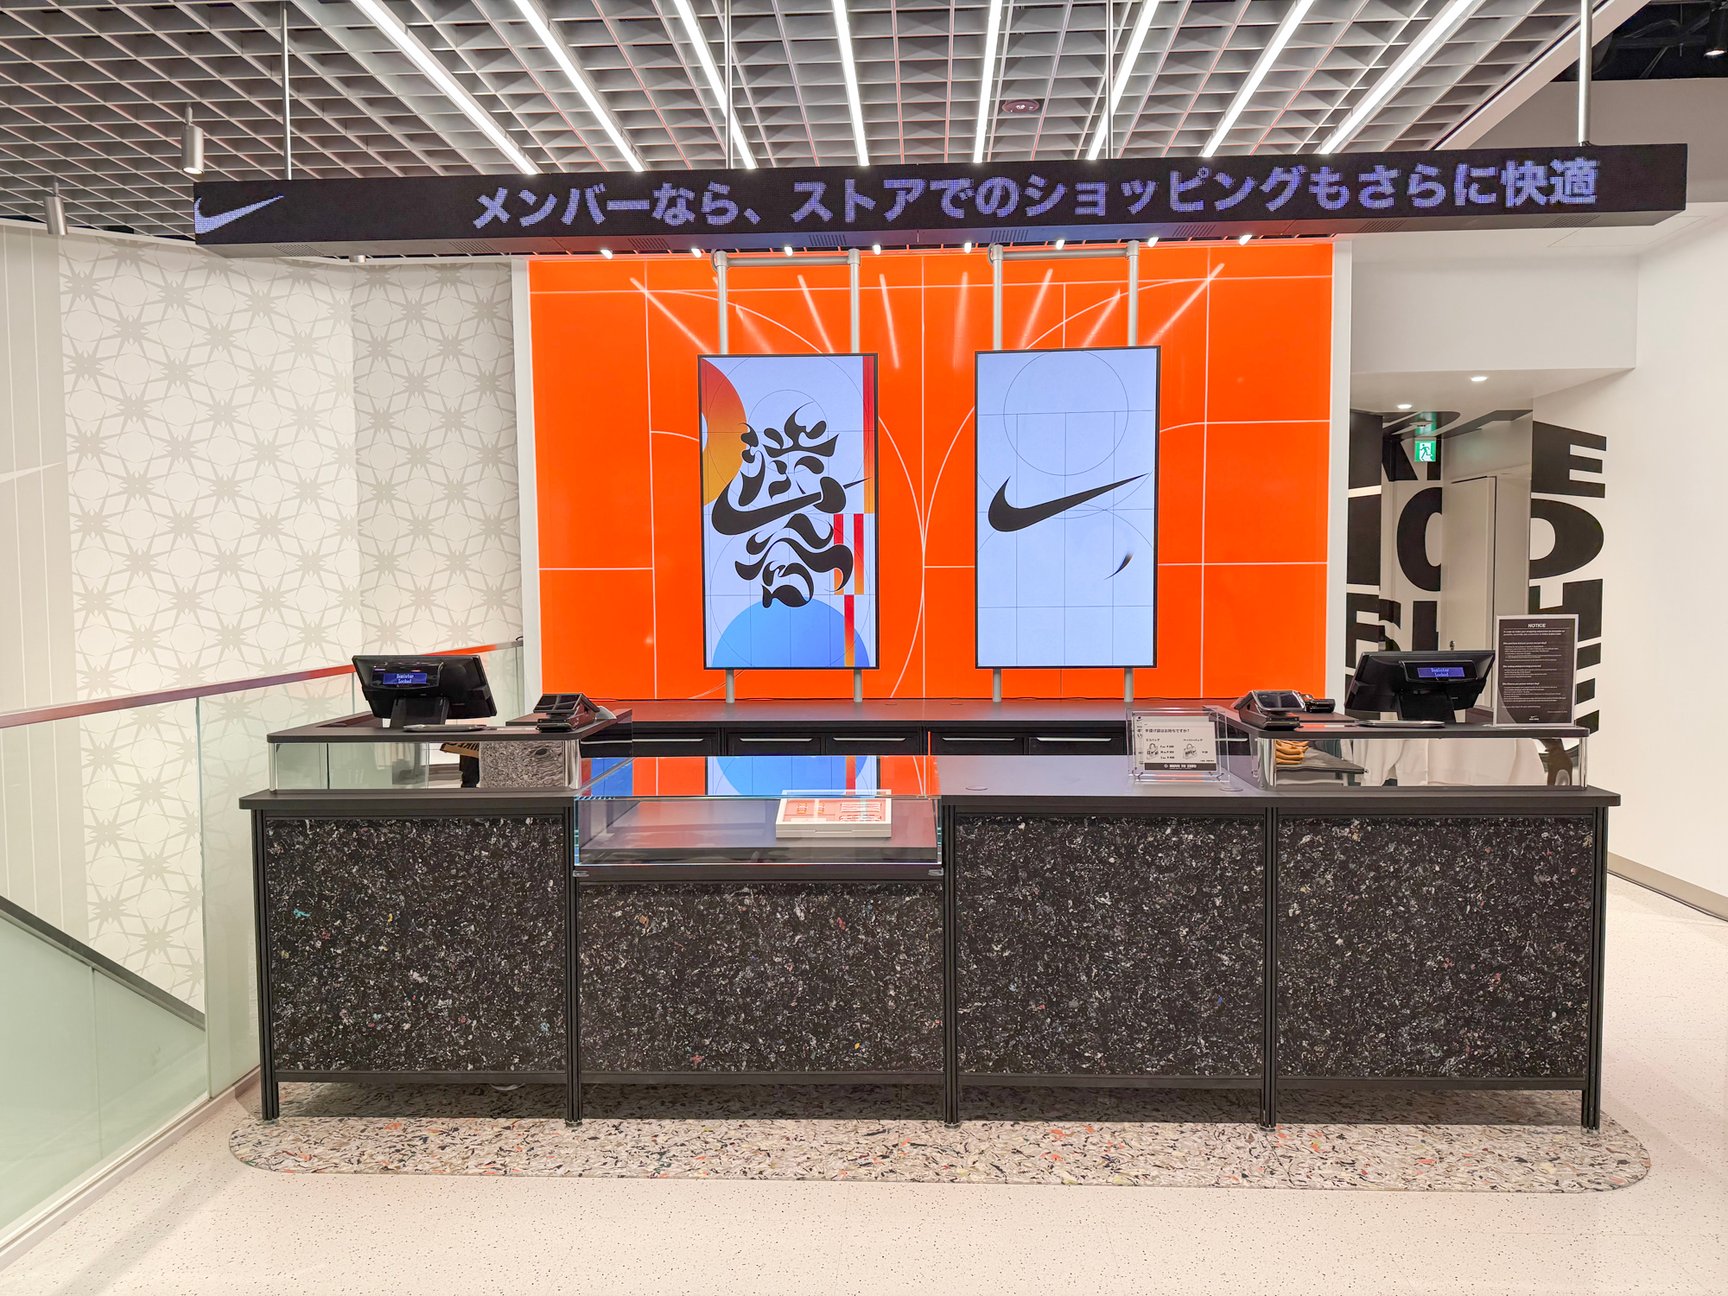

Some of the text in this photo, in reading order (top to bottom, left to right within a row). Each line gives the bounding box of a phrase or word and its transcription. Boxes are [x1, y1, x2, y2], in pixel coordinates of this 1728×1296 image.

[473, 157, 1599, 229] メンバーなら、ストアでのショッピングもさらに快適
